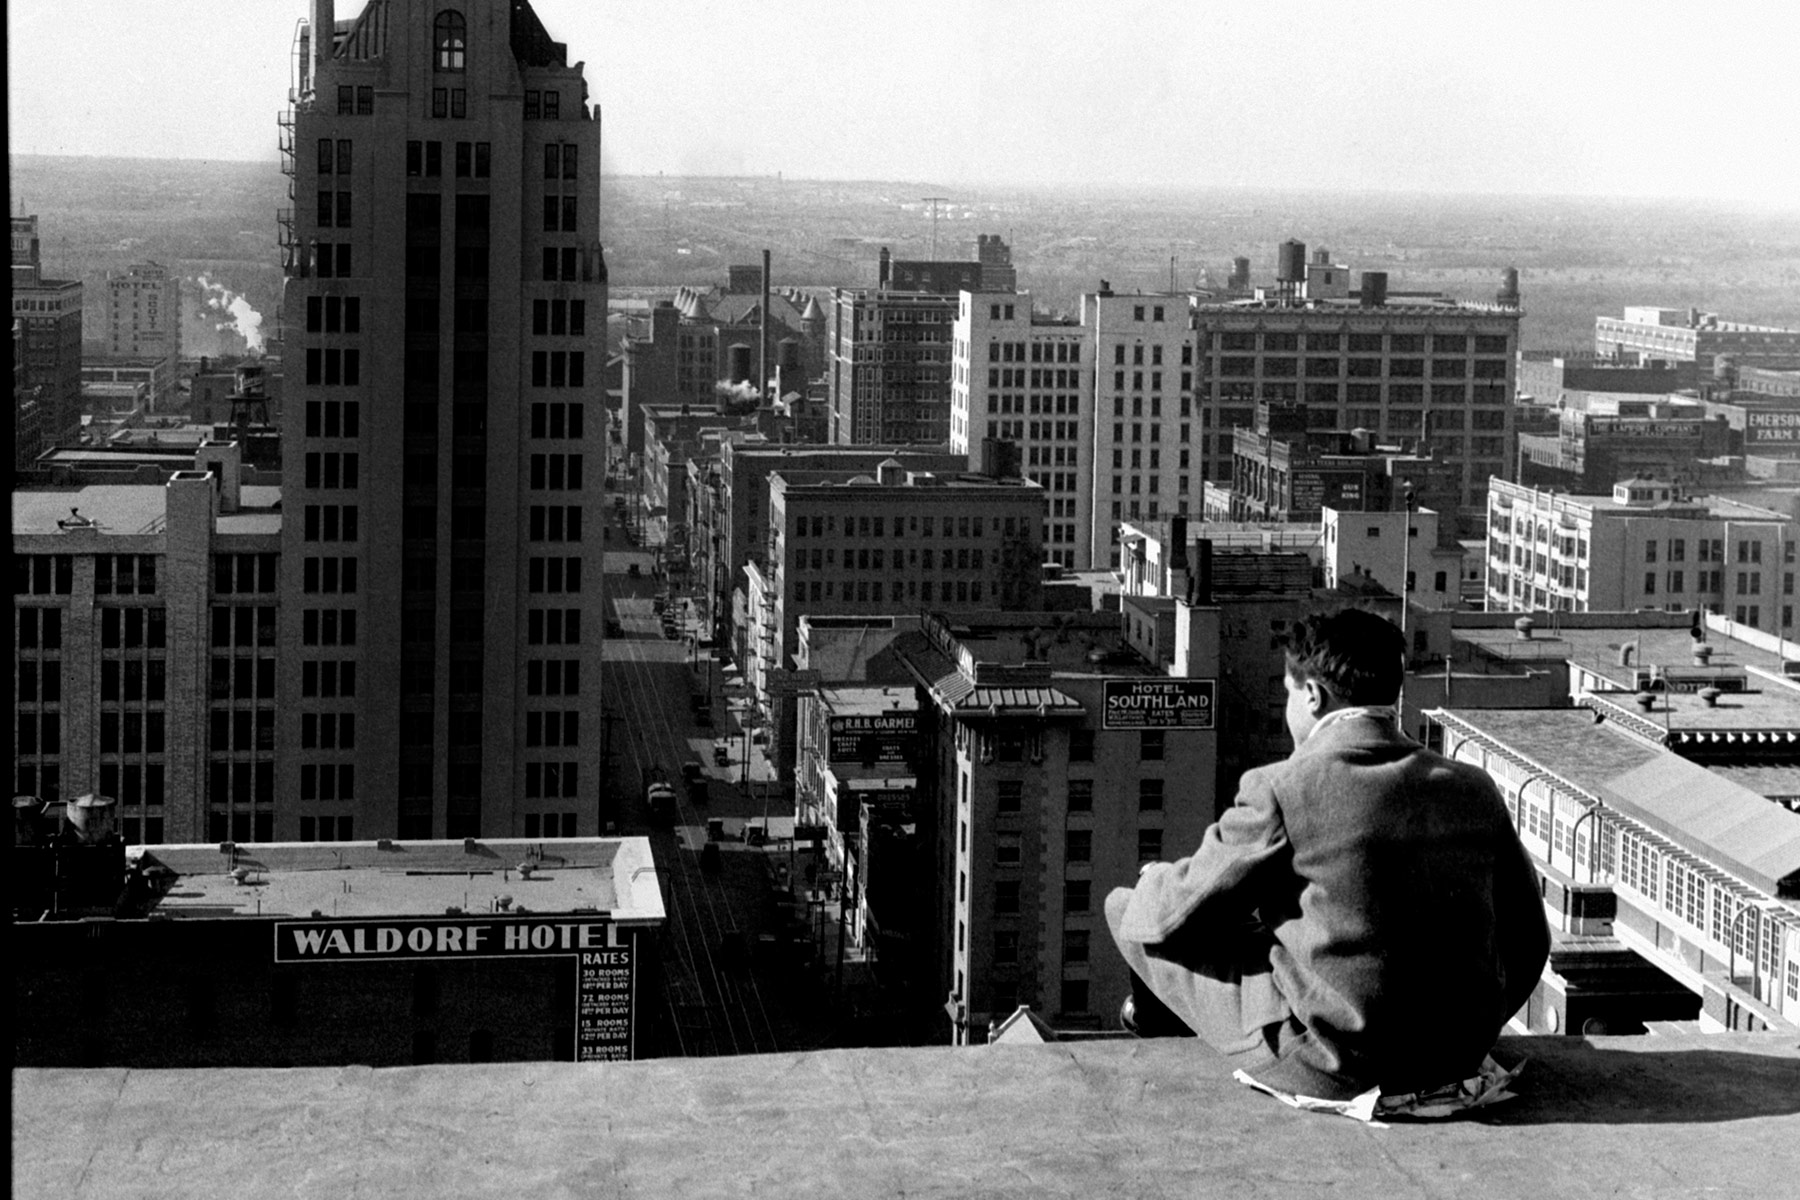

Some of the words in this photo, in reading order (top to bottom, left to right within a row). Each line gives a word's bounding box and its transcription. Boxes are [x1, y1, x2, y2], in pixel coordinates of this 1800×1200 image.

[110, 281, 162, 290] HOTEL
[148, 294, 158, 329] SCOTT
[1757, 429, 1793, 440] FARM
[1132, 684, 1185, 694] HOTEL
[1108, 694, 1209, 709] SOUTHLAND
[292, 925, 492, 955] WALDORF
[504, 922, 630, 951] HOTEL
[583, 952, 629, 965] RATES
[583, 968, 596, 977] 30
[598, 968, 630, 977] ROOMS
[582, 994, 594, 1002] 72
[598, 993, 630, 1002] ROOMS
[595, 1007, 611, 1015] PER
[612, 1006, 629, 1014] DAY
[581, 1019, 591, 1028] 15
[597, 1018, 629, 1027] ROOMS
[596, 1032, 611, 1040] PER
[612, 1031, 628, 1039] DAY
[581, 1045, 593, 1054] 33
[596, 1045, 628, 1054] ROOMS
